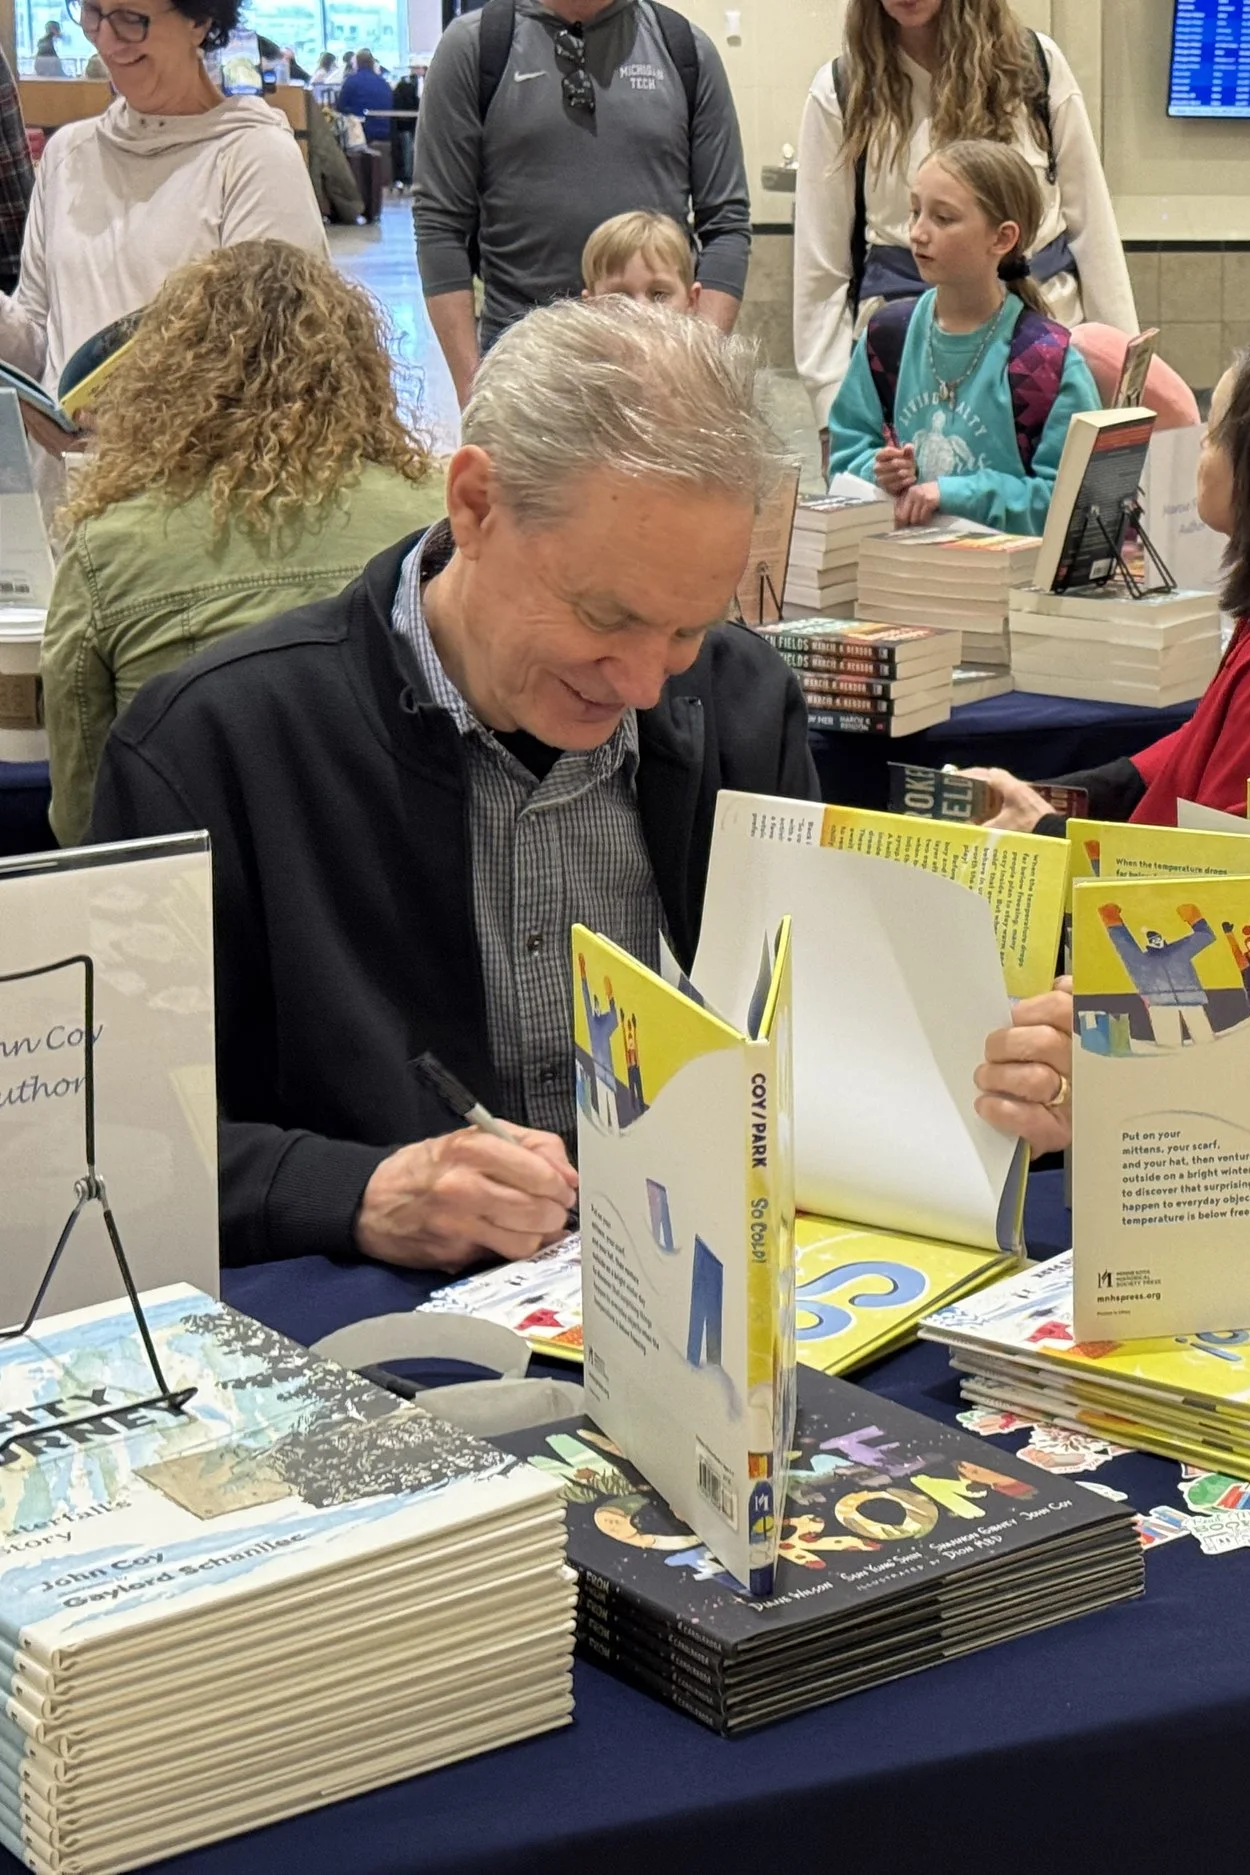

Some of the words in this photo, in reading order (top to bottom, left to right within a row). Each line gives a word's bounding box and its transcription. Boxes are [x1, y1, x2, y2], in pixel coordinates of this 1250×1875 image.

[620, 64, 664, 80] MICHIGAN
[630, 77, 656, 89] TECH
[899, 392, 940, 426] LIVING
[955, 401, 987, 436] ALTY
[779, 636, 809, 651] FIELDS
[781, 652, 809, 668] IELDS
[1115, 858, 1138, 868] When
[1139, 860, 1153, 869] the
[1154, 861, 1204, 874] temperature
[0, 1074, 87, 1108] uthor
[751, 1073, 767, 1111] COY
[1122, 1132, 1140, 1141] Put
[1142, 1132, 1156, 1140] on
[1158, 1130, 1181, 1141] your
[751, 1122, 768, 1169] PARK
[1122, 1144, 1164, 1155] mittens,
[1167, 1143, 1190, 1153] your
[1122, 1160, 1141, 1170] and
[1143, 1159, 1167, 1170] your
[1192, 1156, 1215, 1165] then
[1122, 1174, 1161, 1184] outside
[1163, 1173, 1176, 1181] on
[1187, 1168, 1218, 1180] bright
[1122, 1189, 1133, 1198] to
[1135, 1187, 1178, 1197] discover
[1180, 1185, 1201, 1193] that
[1122, 1202, 1160, 1212] happen
[1163, 1200, 1174, 1209] to
[1176, 1197, 1221, 1208] everyday
[1122, 1214, 1185, 1227] temperature
[1187, 1212, 1196, 1221] is
[1198, 1211, 1228, 1220] below
[1097, 1292, 1161, 1303] mnhspress.org
[749, 1594, 792, 1612] DIANE
[788, 1580, 834, 1601] WILSON
[929, 1532, 980, 1552] SHANNON
[1019, 1507, 1051, 1521] JOHN
[1048, 1499, 1073, 1511] COY
[942, 1545, 975, 1560] DION
[41, 1566, 107, 1592] John
[111, 1552, 164, 1571] Coy
[62, 1571, 175, 1608] Gaylord
[586, 1570, 610, 1593] FROM
